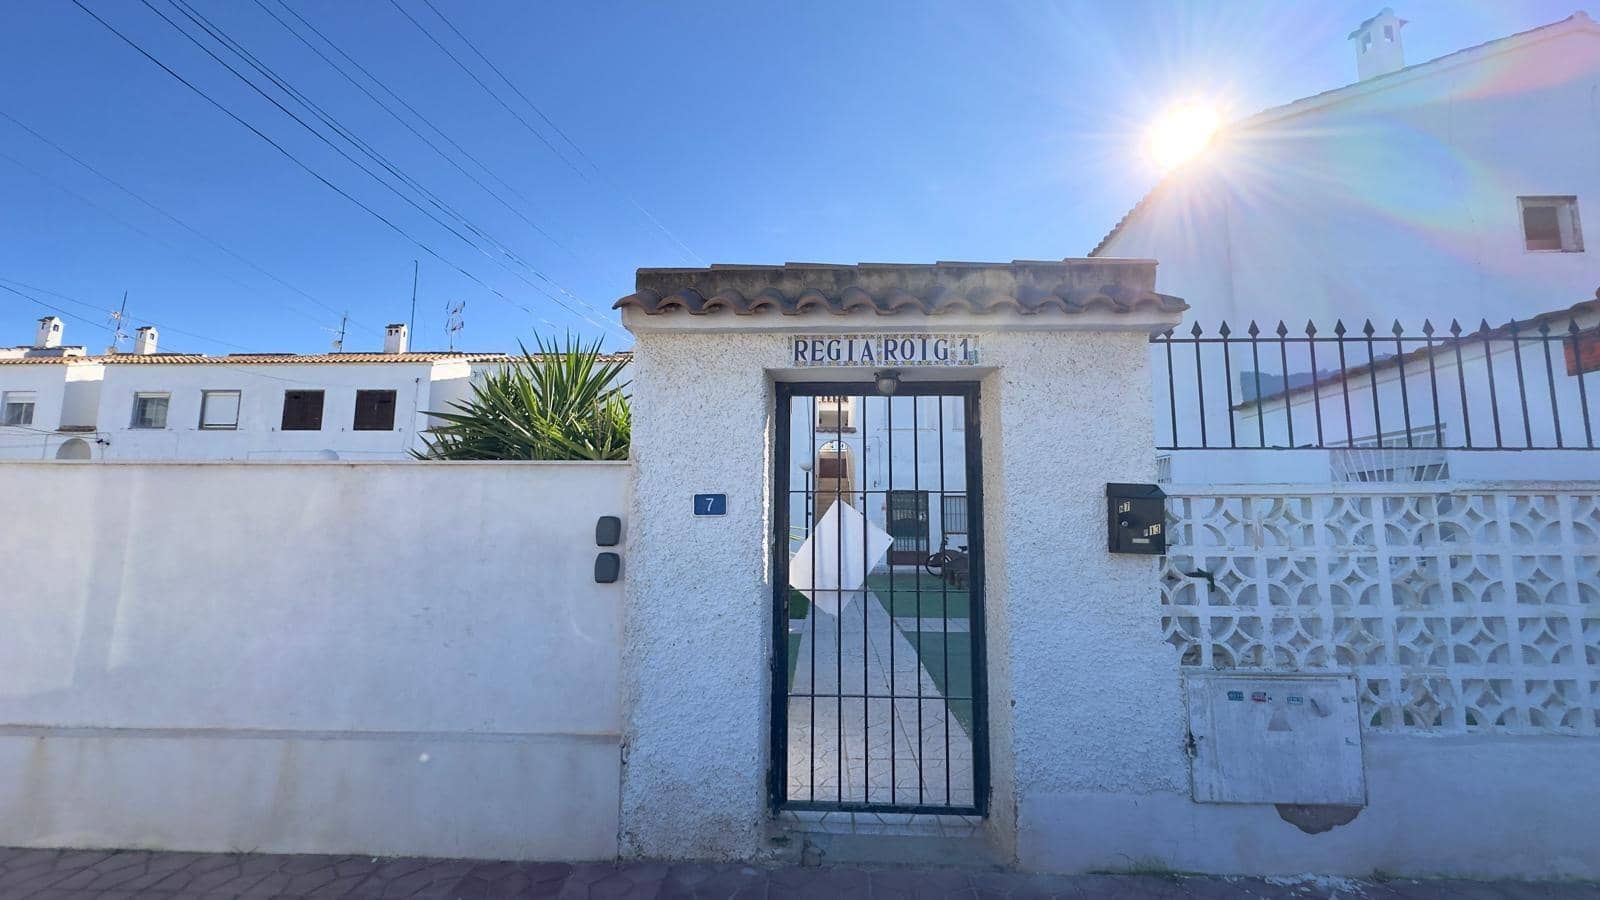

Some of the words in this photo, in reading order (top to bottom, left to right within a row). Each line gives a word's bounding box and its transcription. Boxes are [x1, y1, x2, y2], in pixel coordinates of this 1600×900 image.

[793, 339, 875, 362] REGIA
[884, 338, 949, 361] ROIG
[959, 338, 969, 360] 1
[705, 497, 714, 512] 7
